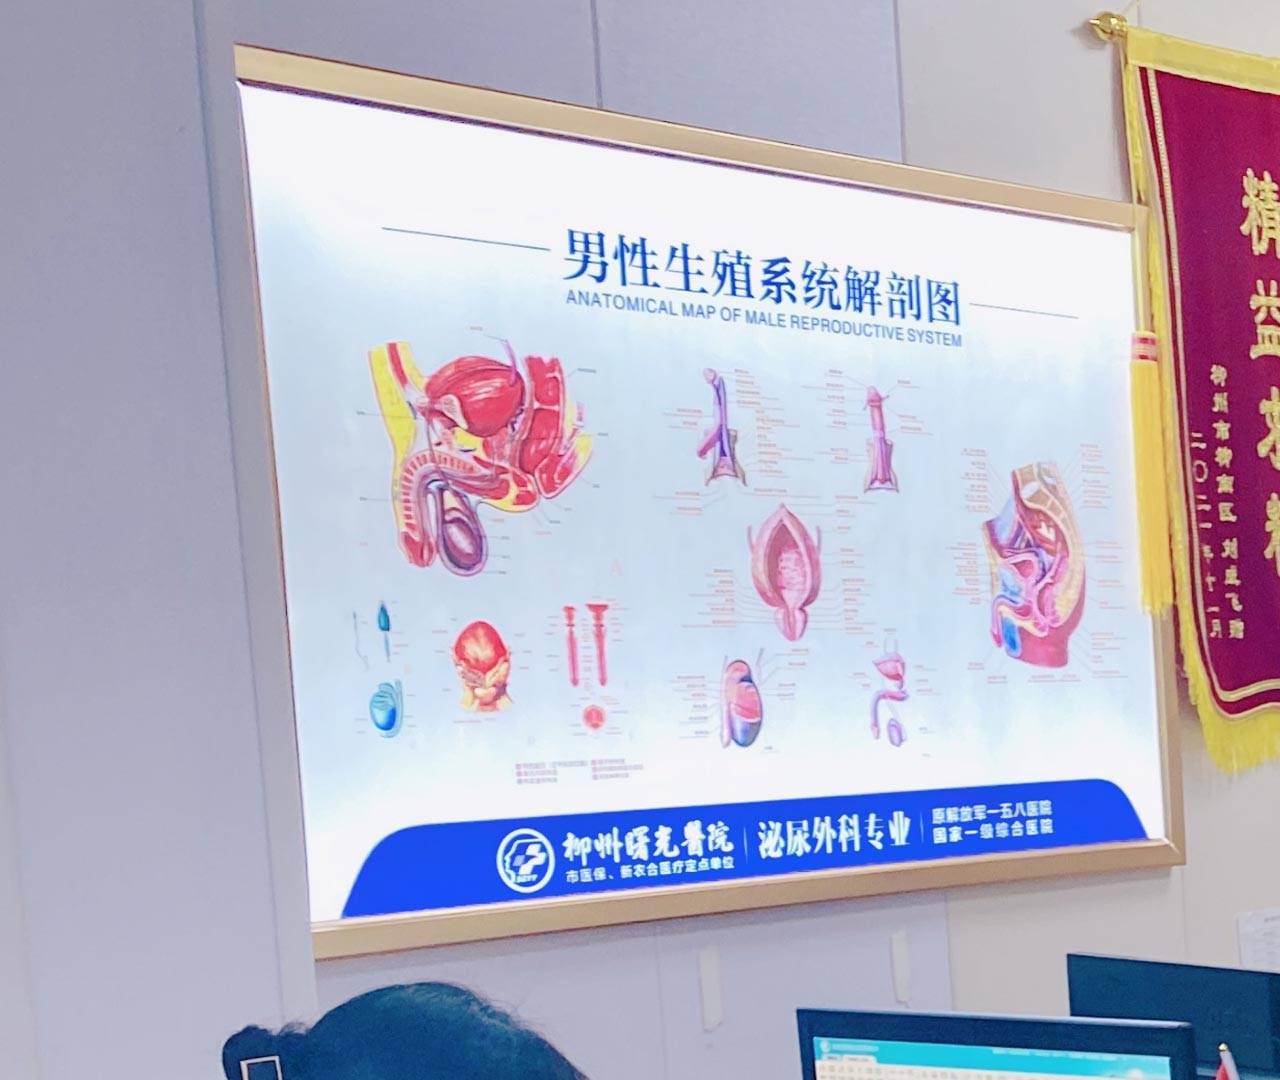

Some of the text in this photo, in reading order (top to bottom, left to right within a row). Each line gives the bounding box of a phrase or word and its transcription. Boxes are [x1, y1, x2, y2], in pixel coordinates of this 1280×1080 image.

[563, 228, 961, 326] 男性生殖系统解剖图
[566, 289, 962, 347] ANATOMICAL MAP OF MALE REPRODUCTIVE SYSTEM
[757, 810, 911, 859] 泌尿外科专业
[931, 799, 1053, 825] 原解放军一五八医院
[932, 818, 1054, 845] 国家一级综合医院
[562, 819, 735, 868] 柳州曙光醫院
